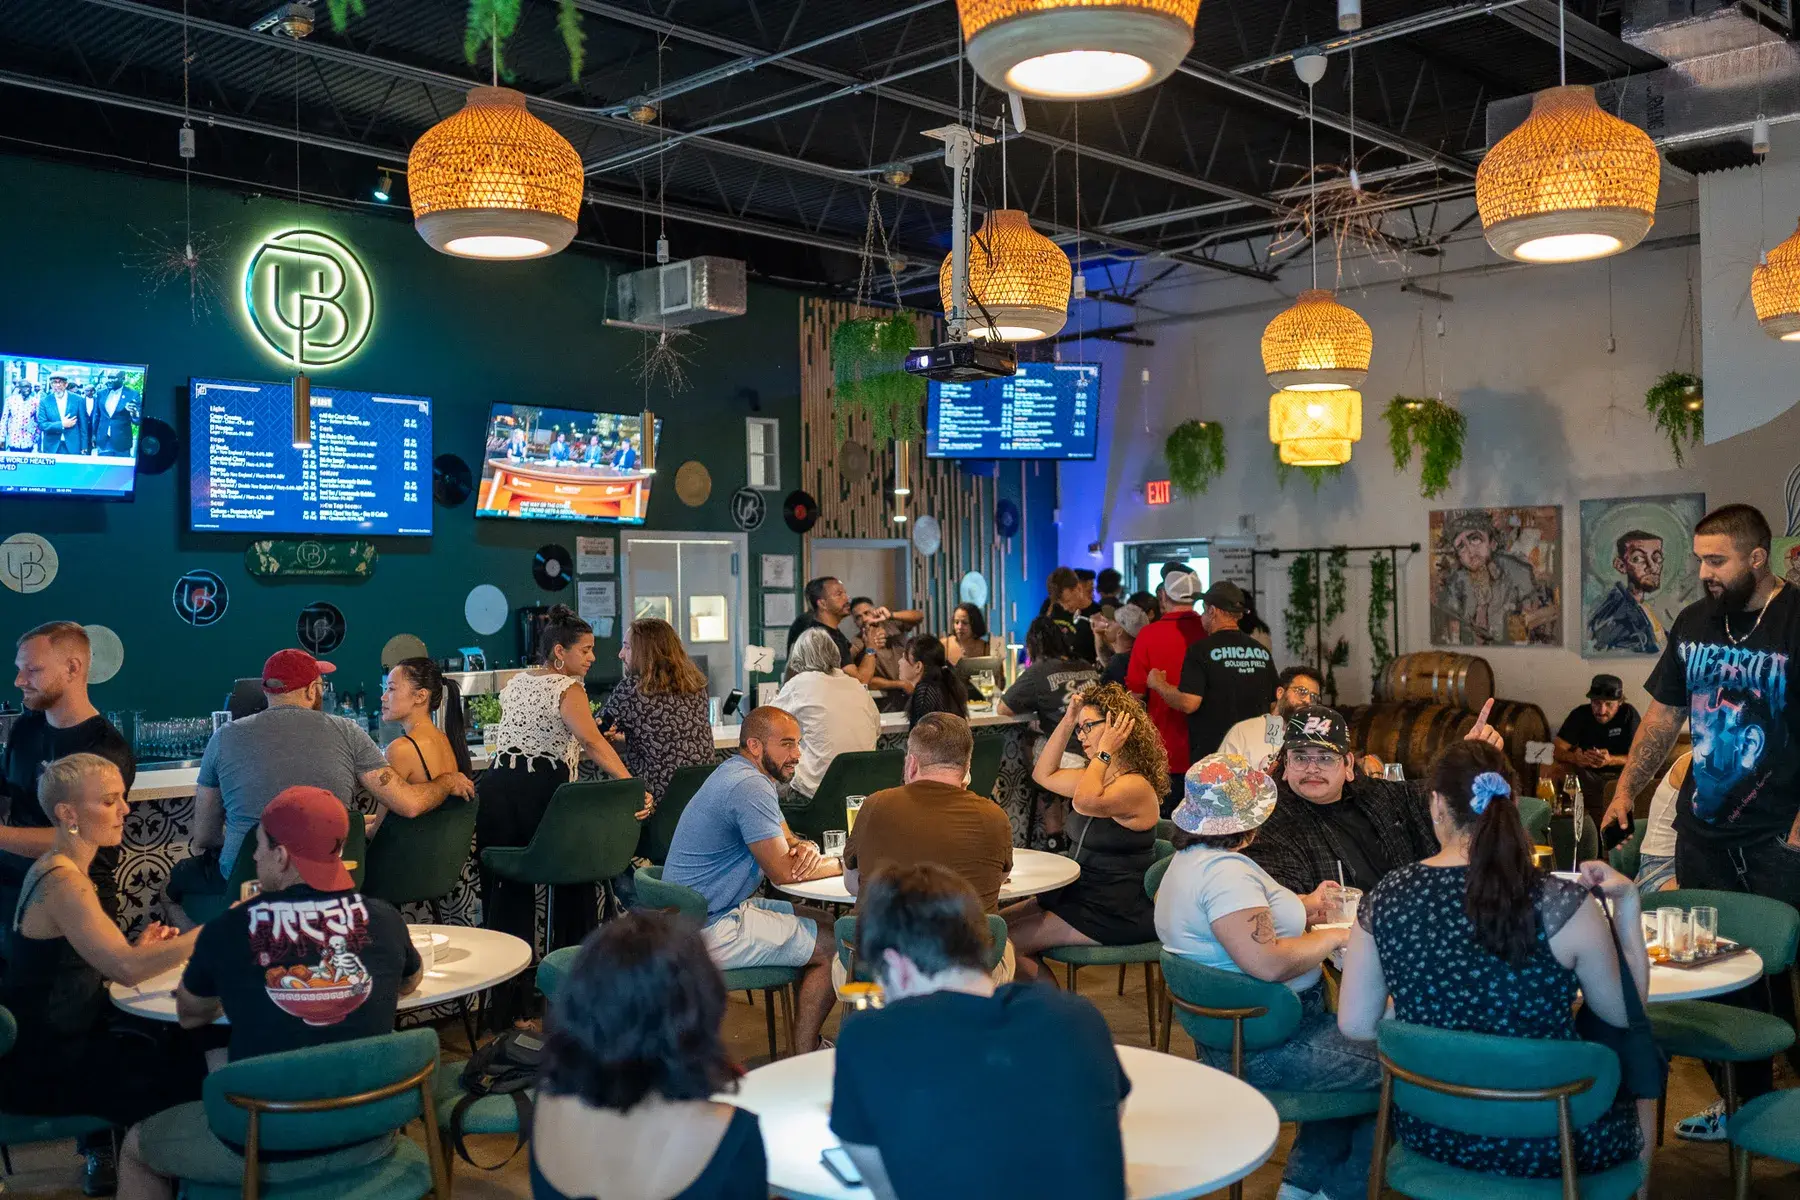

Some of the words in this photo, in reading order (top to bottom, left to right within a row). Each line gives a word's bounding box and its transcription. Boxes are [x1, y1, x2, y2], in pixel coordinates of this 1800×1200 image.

[1148, 481, 1170, 504] EXIT
[1210, 647, 1270, 661] CHICAGO
[1267, 724, 1280, 736] 23
[1303, 717, 1332, 735] 24
[248, 894, 369, 941] FRESH
